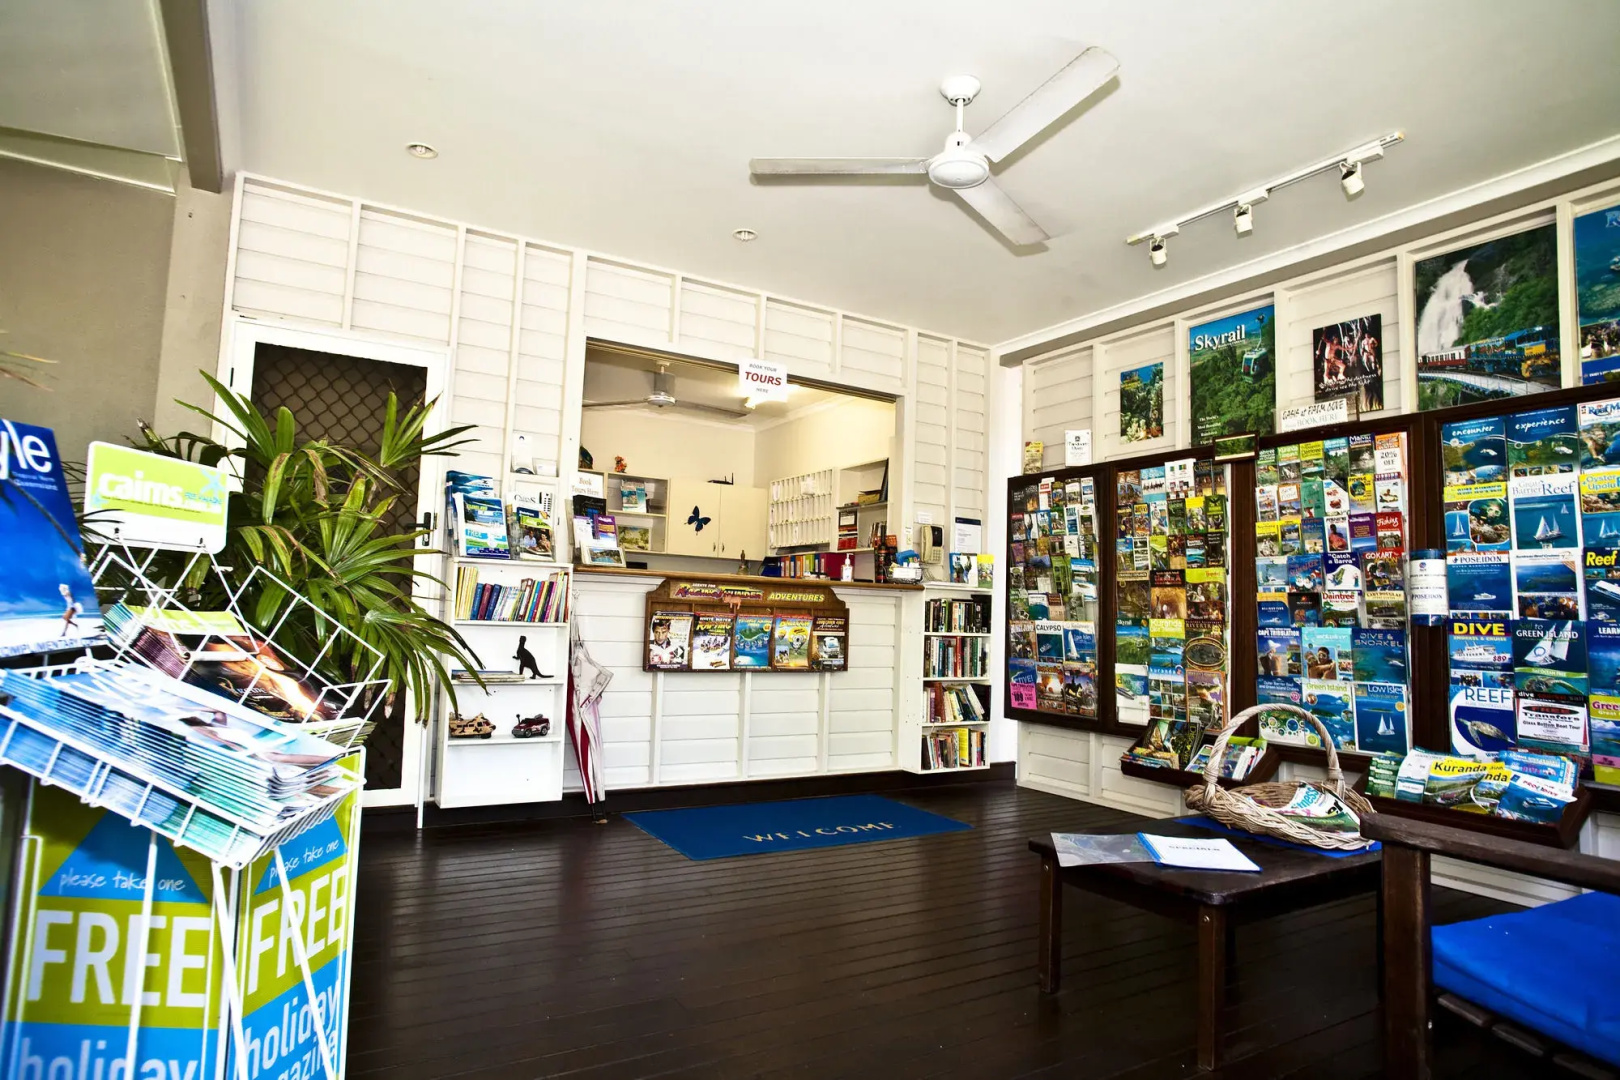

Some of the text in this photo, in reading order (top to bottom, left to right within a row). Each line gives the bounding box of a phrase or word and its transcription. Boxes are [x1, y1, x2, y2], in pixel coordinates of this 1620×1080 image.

[1195, 324, 1246, 351] Skyrail
[745, 371, 782, 386] TOURS
[1452, 425, 1495, 436] encounter
[1515, 418, 1566, 432] experience
[1541, 480, 1575, 495] Reef
[1460, 556, 1502, 564] POSEIDON
[1586, 550, 1618, 566] Reef
[767, 592, 825, 602] ADVENTURES
[1323, 592, 1355, 600] Daintree
[1453, 622, 1506, 636] DIVE
[1516, 629, 1544, 637] GREEN
[1355, 639, 1403, 648] SNORKEL
[1306, 683, 1347, 692] Green Island
[1368, 684, 1386, 693] Low
[1465, 687, 1511, 703] REEF
[1592, 701, 1620, 711] Gree
[1434, 761, 1487, 774] Kuranda
[742, 821, 894, 842] WELCOME
[303, 845, 324, 864] take
[326, 839, 340, 854] one
[59, 867, 186, 894] please take one
[247, 864, 348, 995] FREE
[27, 909, 212, 1008] FREE
